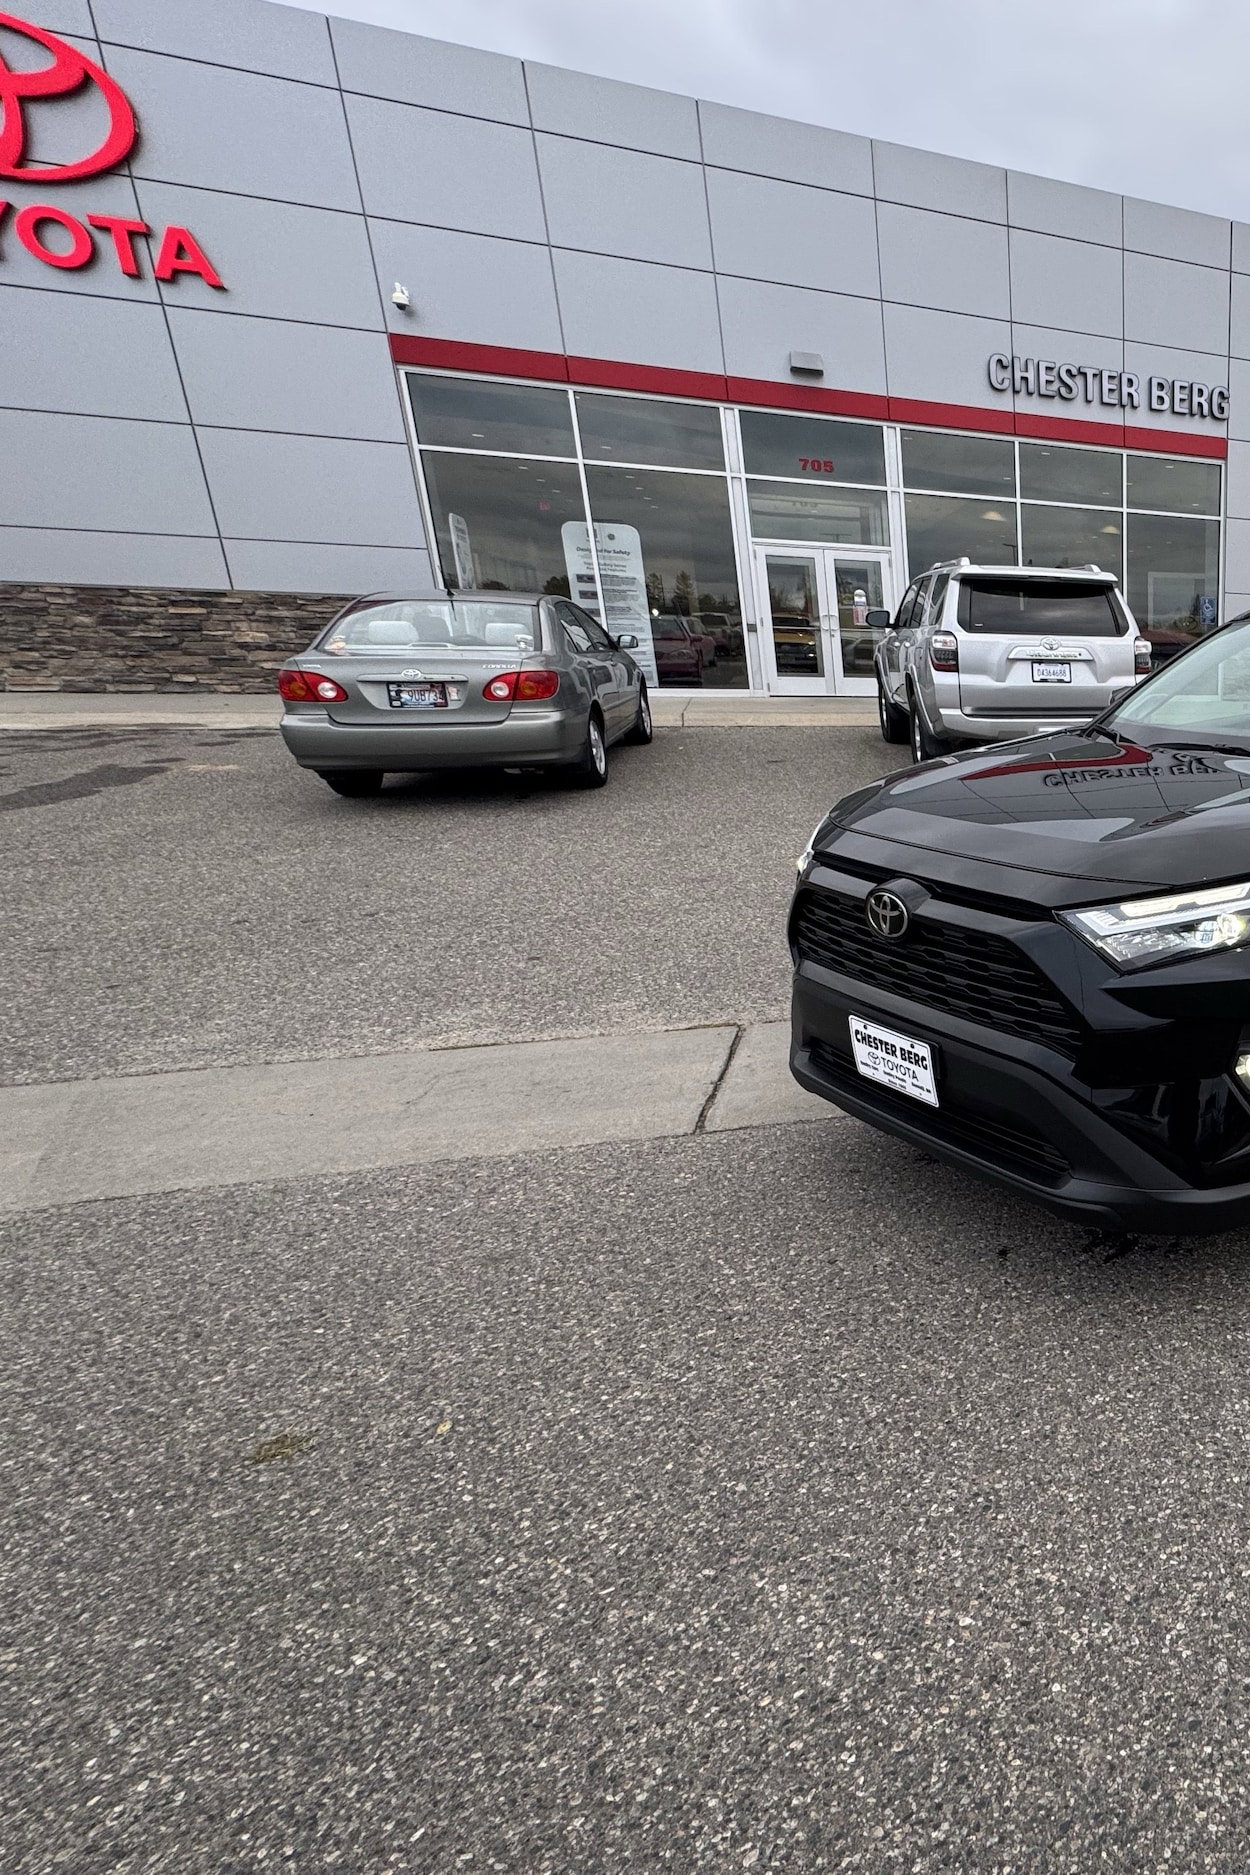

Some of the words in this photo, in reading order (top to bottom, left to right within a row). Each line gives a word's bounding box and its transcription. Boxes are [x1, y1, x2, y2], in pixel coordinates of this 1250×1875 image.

[988, 352, 1140, 408] CHESTER
[1149, 376, 1231, 420] BERG
[798, 458, 835, 473] 705
[854, 1029, 898, 1059] CHESTER
[900, 1047, 928, 1071] BERG
[881, 1056, 920, 1082] TOYOTA
